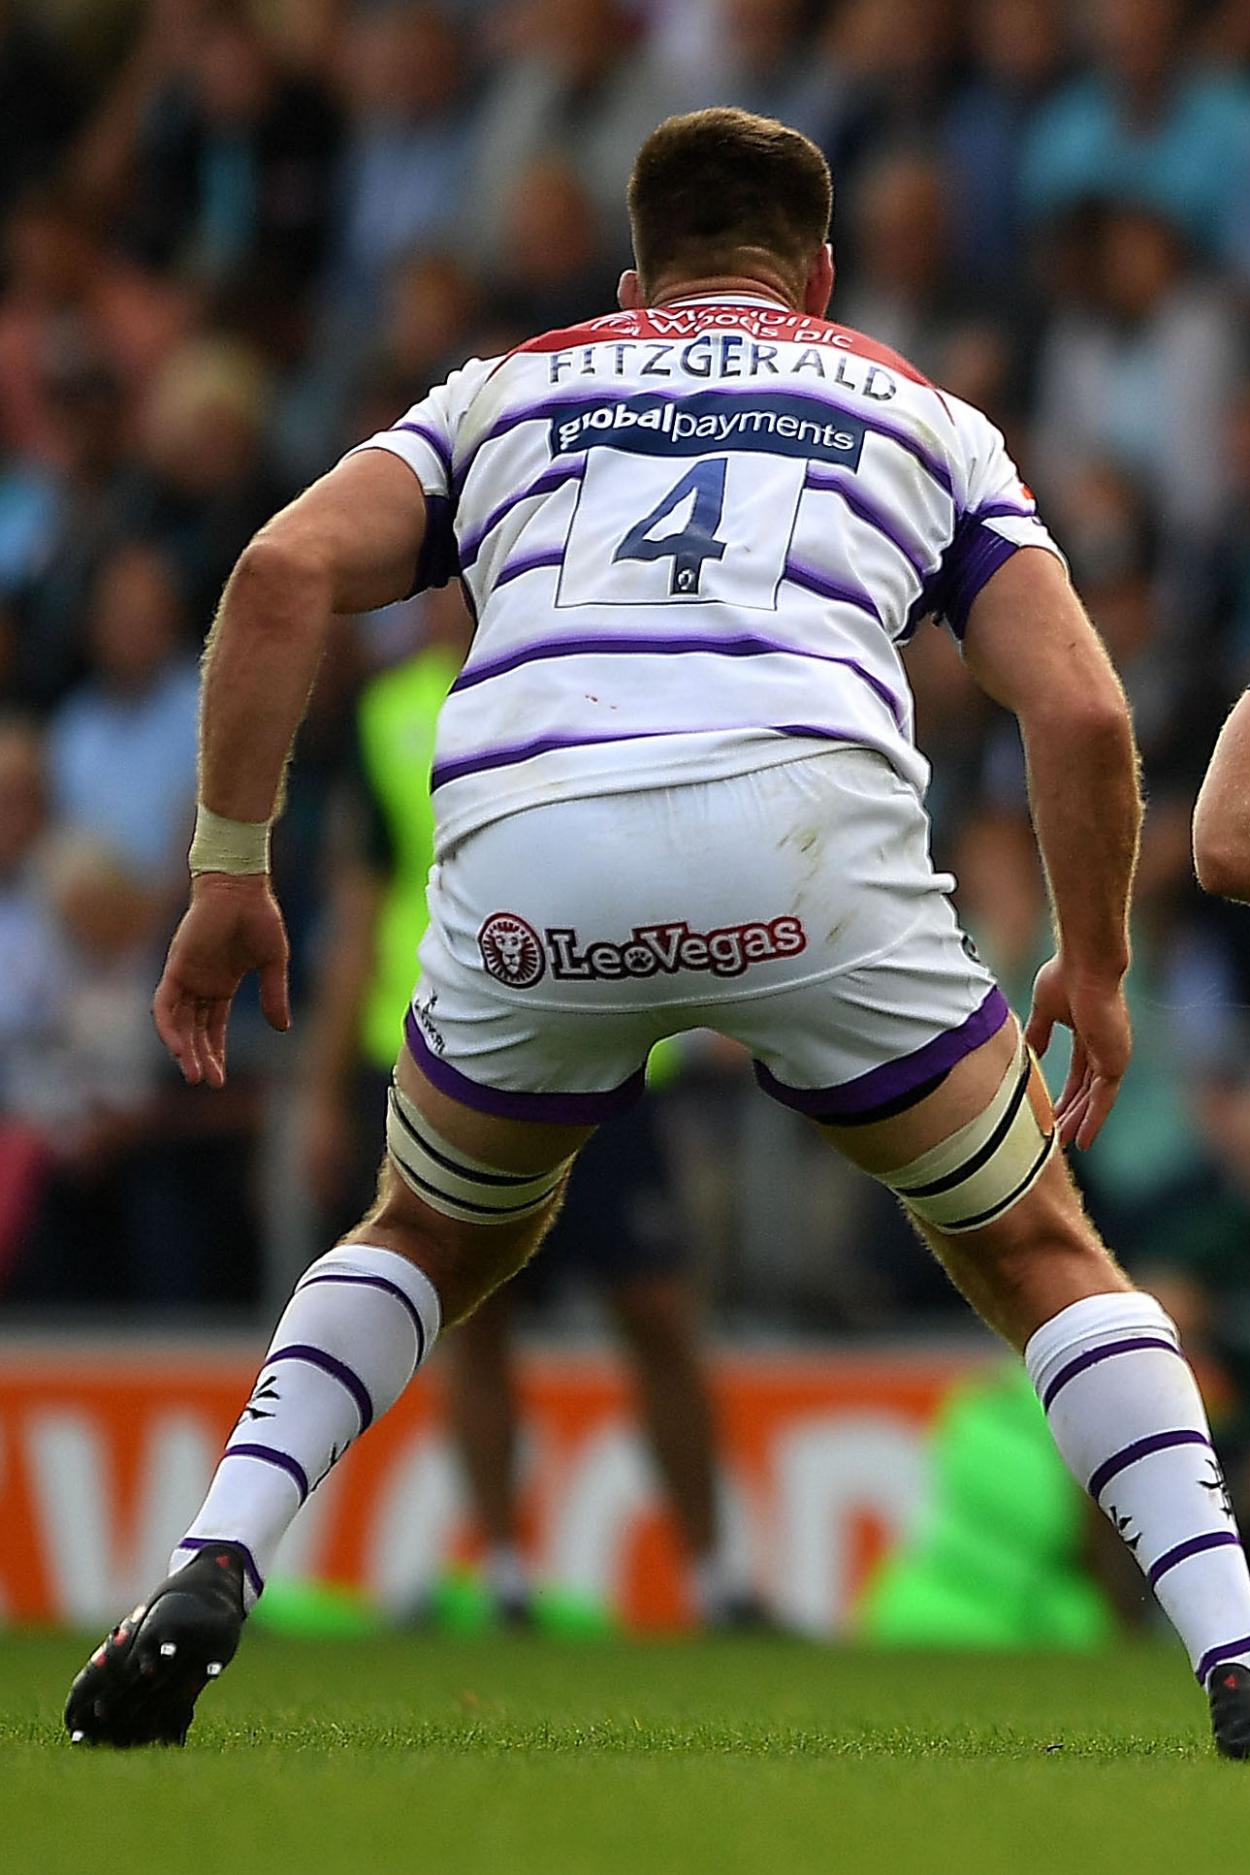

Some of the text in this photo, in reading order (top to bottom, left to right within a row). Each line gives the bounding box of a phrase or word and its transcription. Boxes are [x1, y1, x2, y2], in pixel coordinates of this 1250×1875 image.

[549, 333, 898, 401] FITZGERALD
[793, 328, 853, 350] plc
[558, 402, 855, 451] globalpayments
[611, 456, 728, 595] 4
[548, 919, 804, 976] LeoVegas
